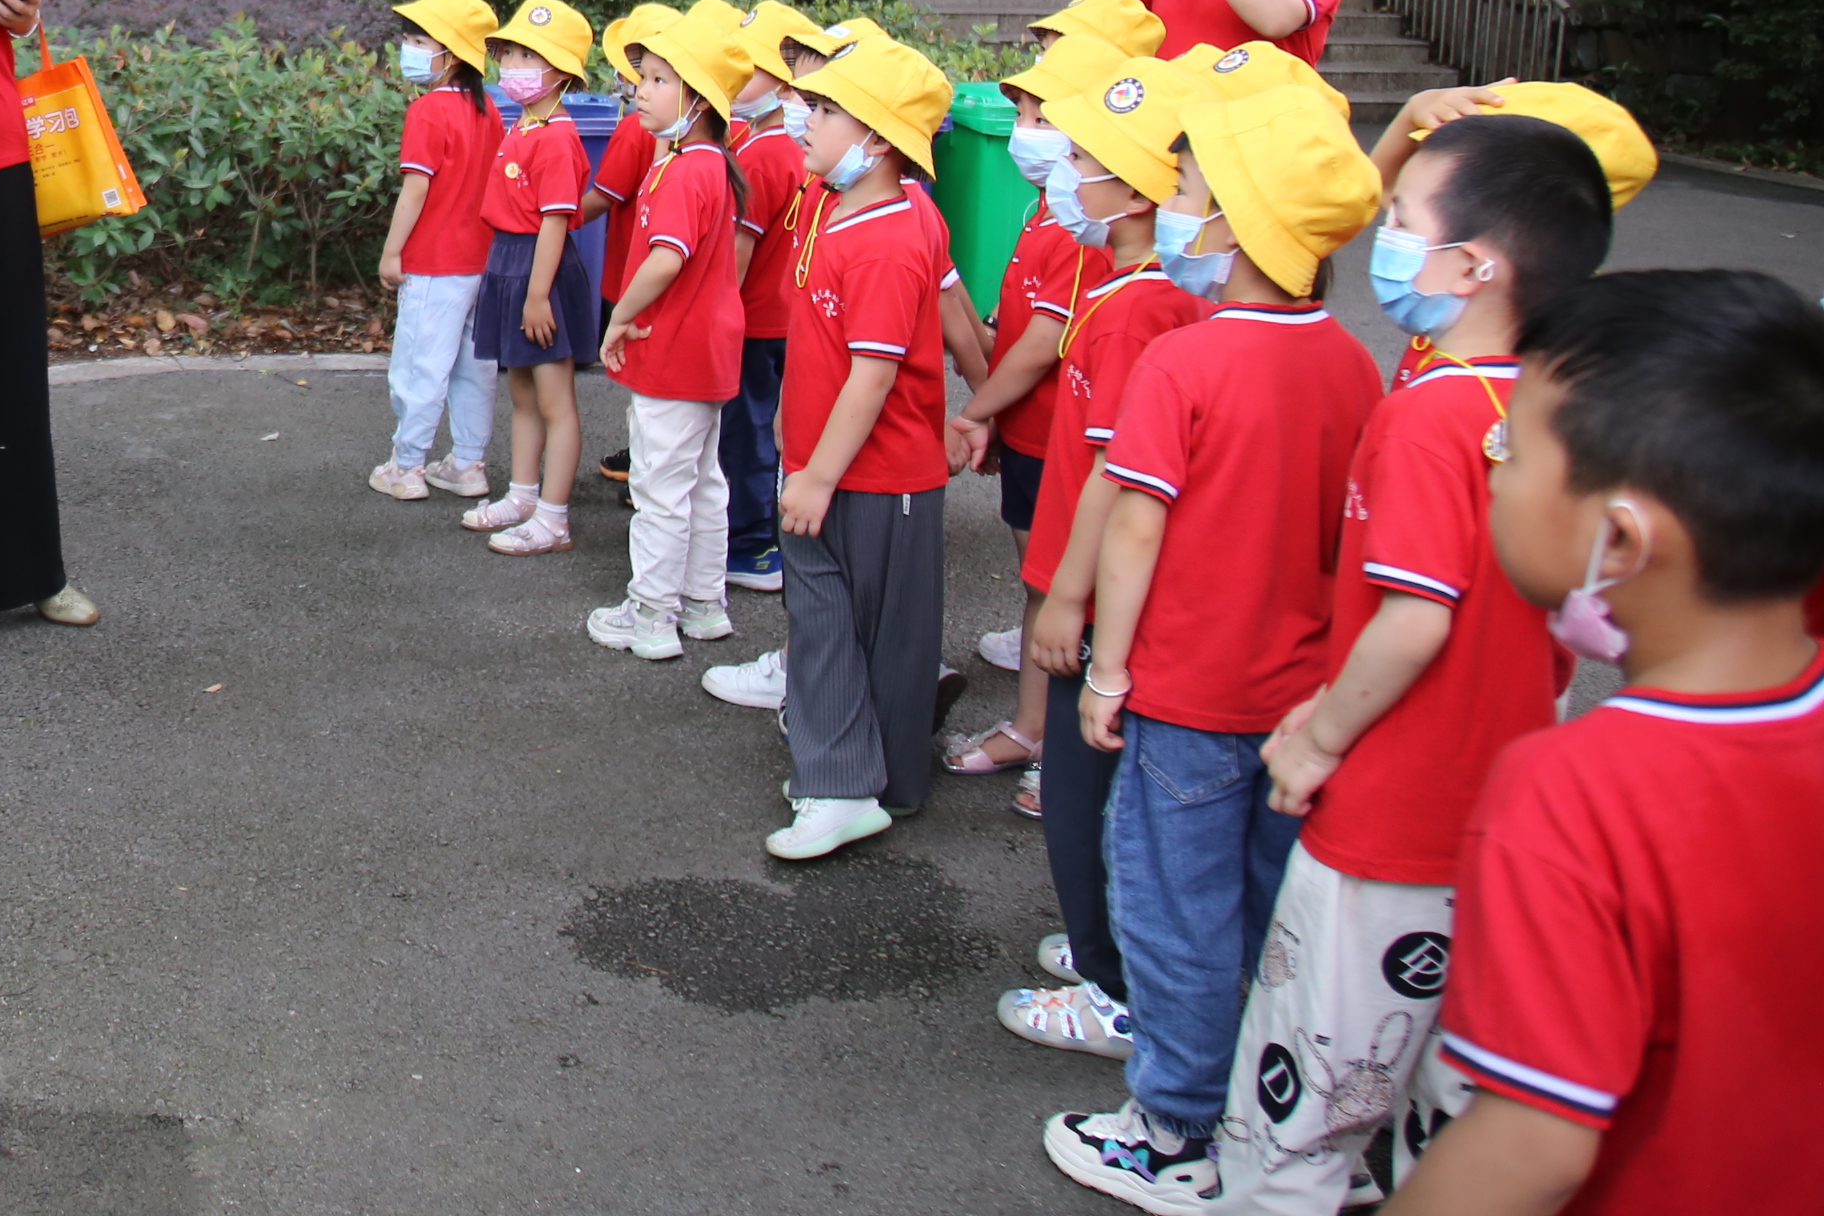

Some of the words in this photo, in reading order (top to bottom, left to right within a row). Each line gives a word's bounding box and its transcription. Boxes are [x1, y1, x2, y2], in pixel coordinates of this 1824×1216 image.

[26, 107, 80, 139] 学习包
[1259, 1056, 1297, 1106] D
